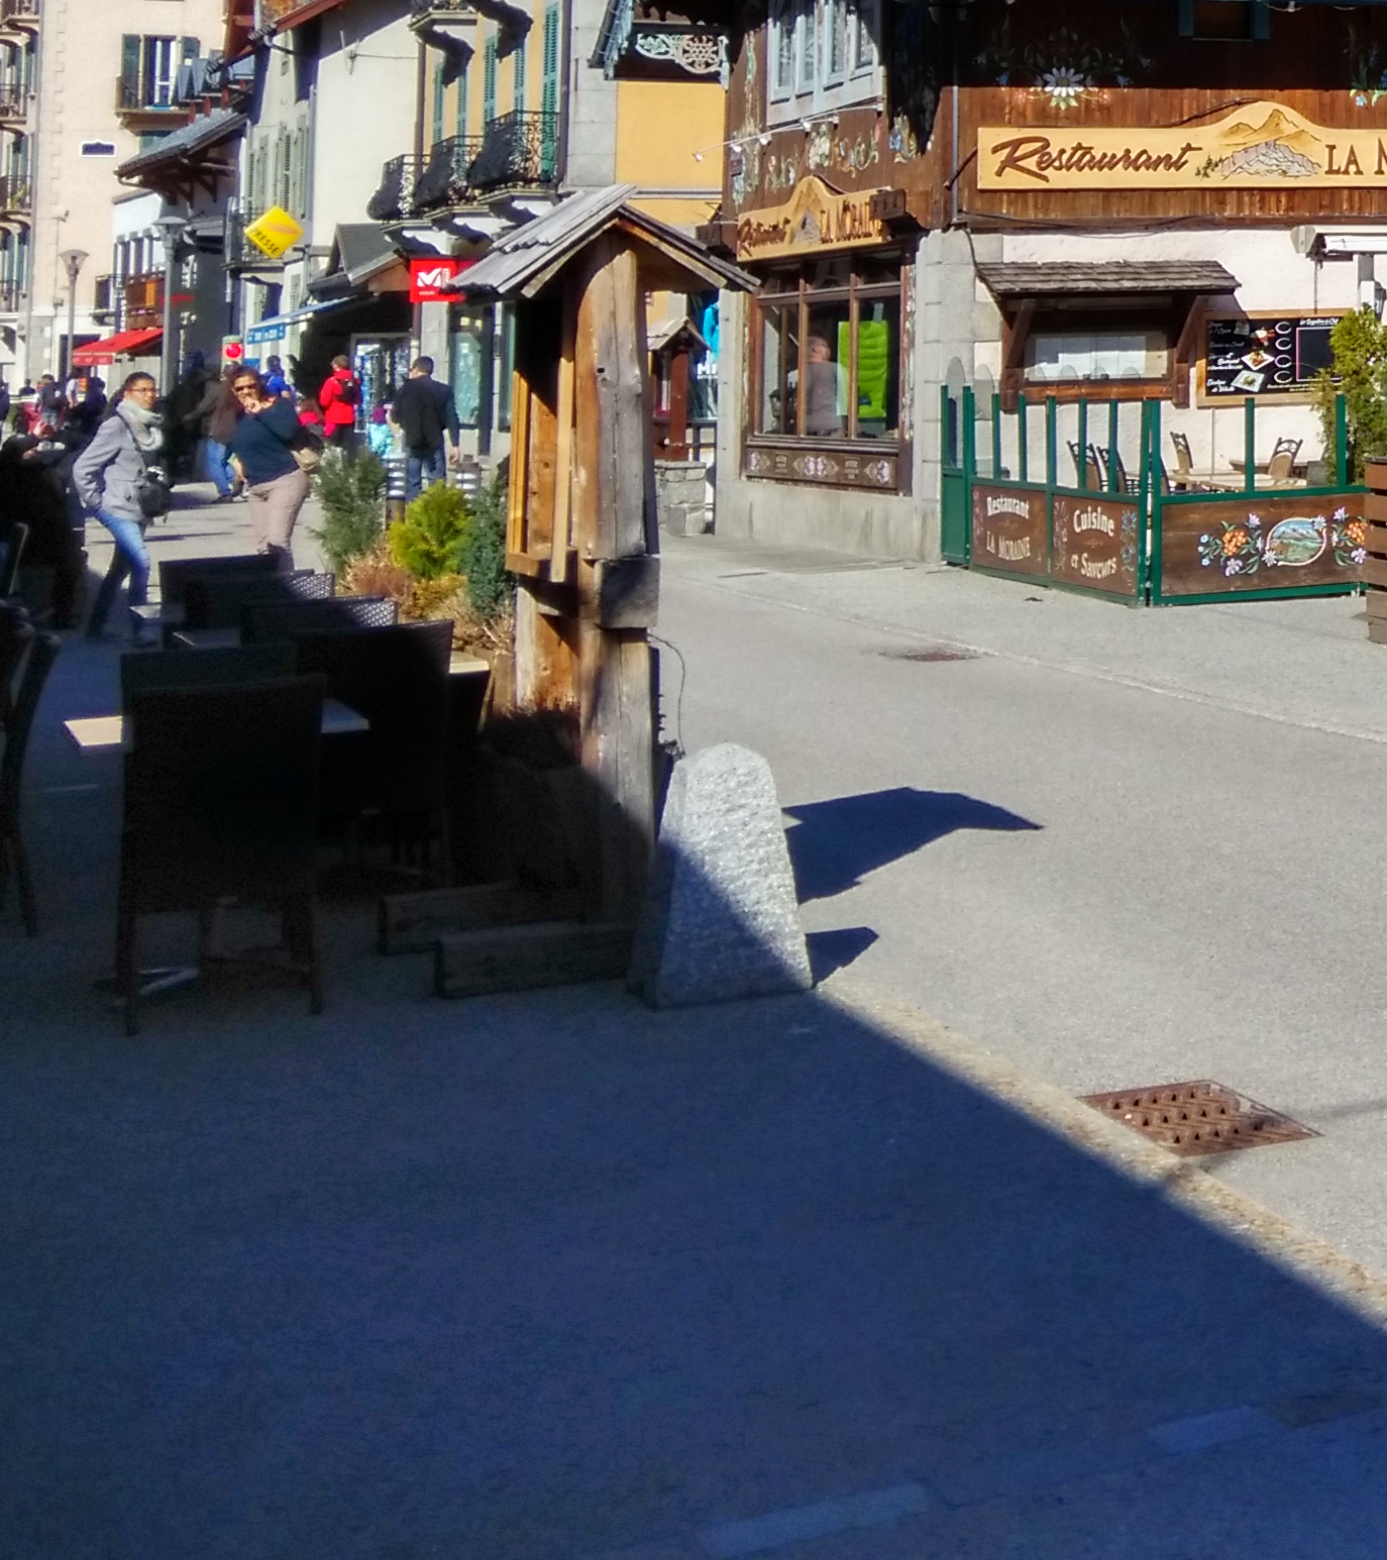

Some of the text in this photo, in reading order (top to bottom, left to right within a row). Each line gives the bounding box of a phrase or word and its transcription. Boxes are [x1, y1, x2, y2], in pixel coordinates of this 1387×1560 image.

[991, 135, 1203, 183] Restaurant
[1325, 144, 1364, 175] LA
[986, 495, 1030, 519] Restaurant
[1073, 505, 1116, 538] Cuisine
[986, 530, 1031, 561] LA MORAINE
[1070, 552, 1117, 580] et Saveurs
